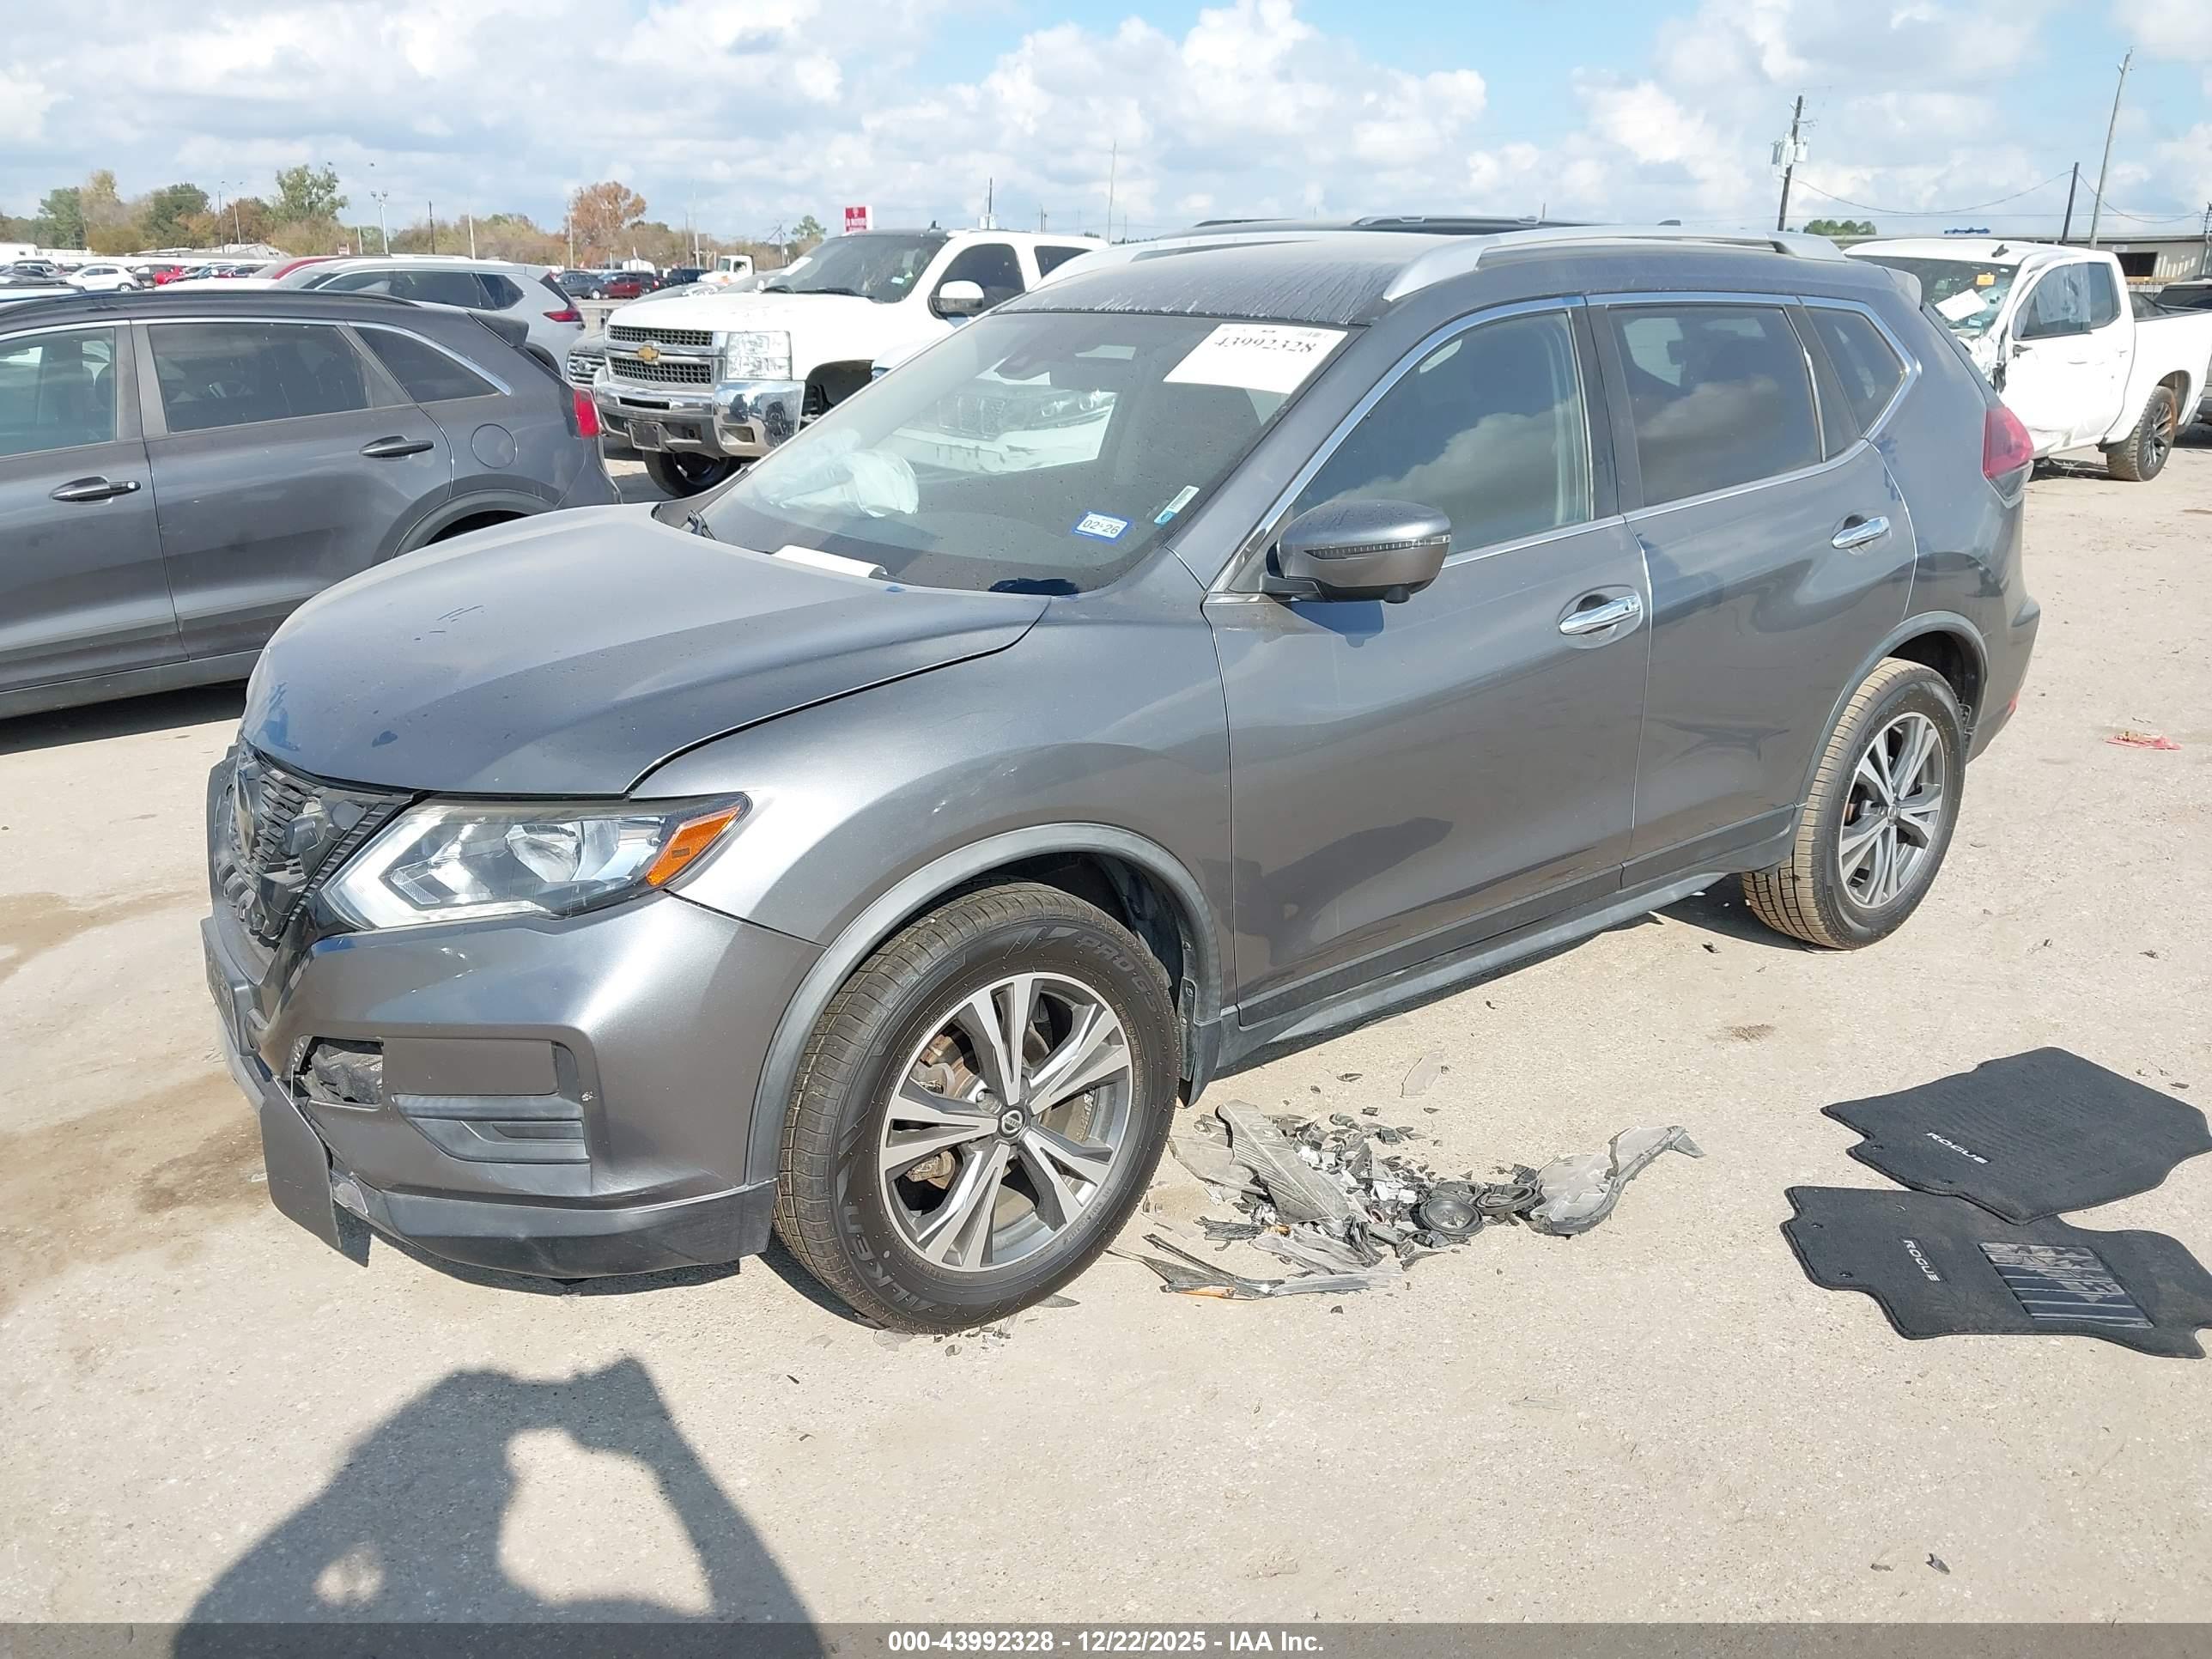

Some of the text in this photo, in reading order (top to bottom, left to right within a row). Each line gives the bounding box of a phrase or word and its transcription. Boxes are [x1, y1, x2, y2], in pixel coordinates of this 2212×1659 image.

[1213, 336, 1316, 353] 43992328
[1924, 1132, 1990, 1164] ROGUE
[1903, 1239, 1942, 1282] ROGUE
